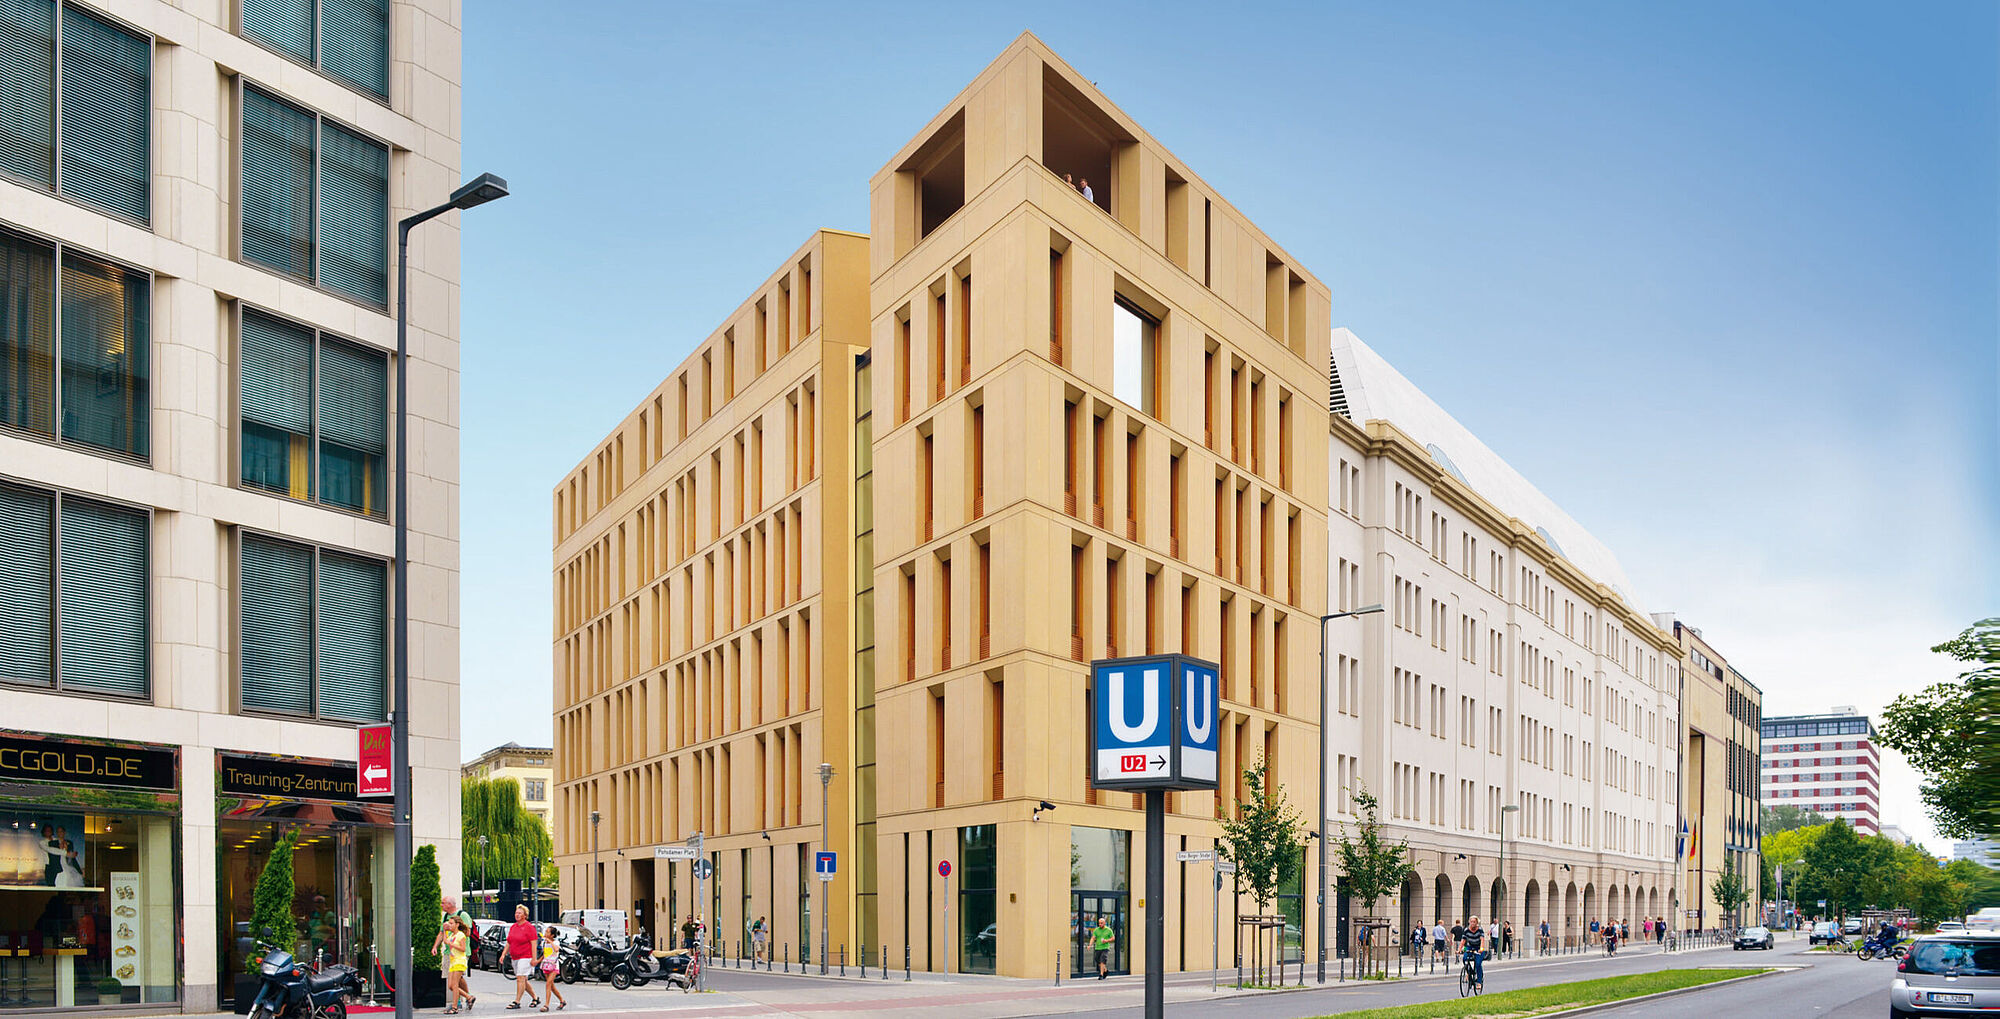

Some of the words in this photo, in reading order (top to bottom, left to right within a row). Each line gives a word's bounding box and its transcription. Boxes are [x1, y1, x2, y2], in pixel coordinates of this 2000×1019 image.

[1108, 668, 1159, 742] U
[1186, 669, 1212, 744] U
[226, 768, 357, 793] Trauring-Zentrum
[1123, 757, 1143, 770] U2
